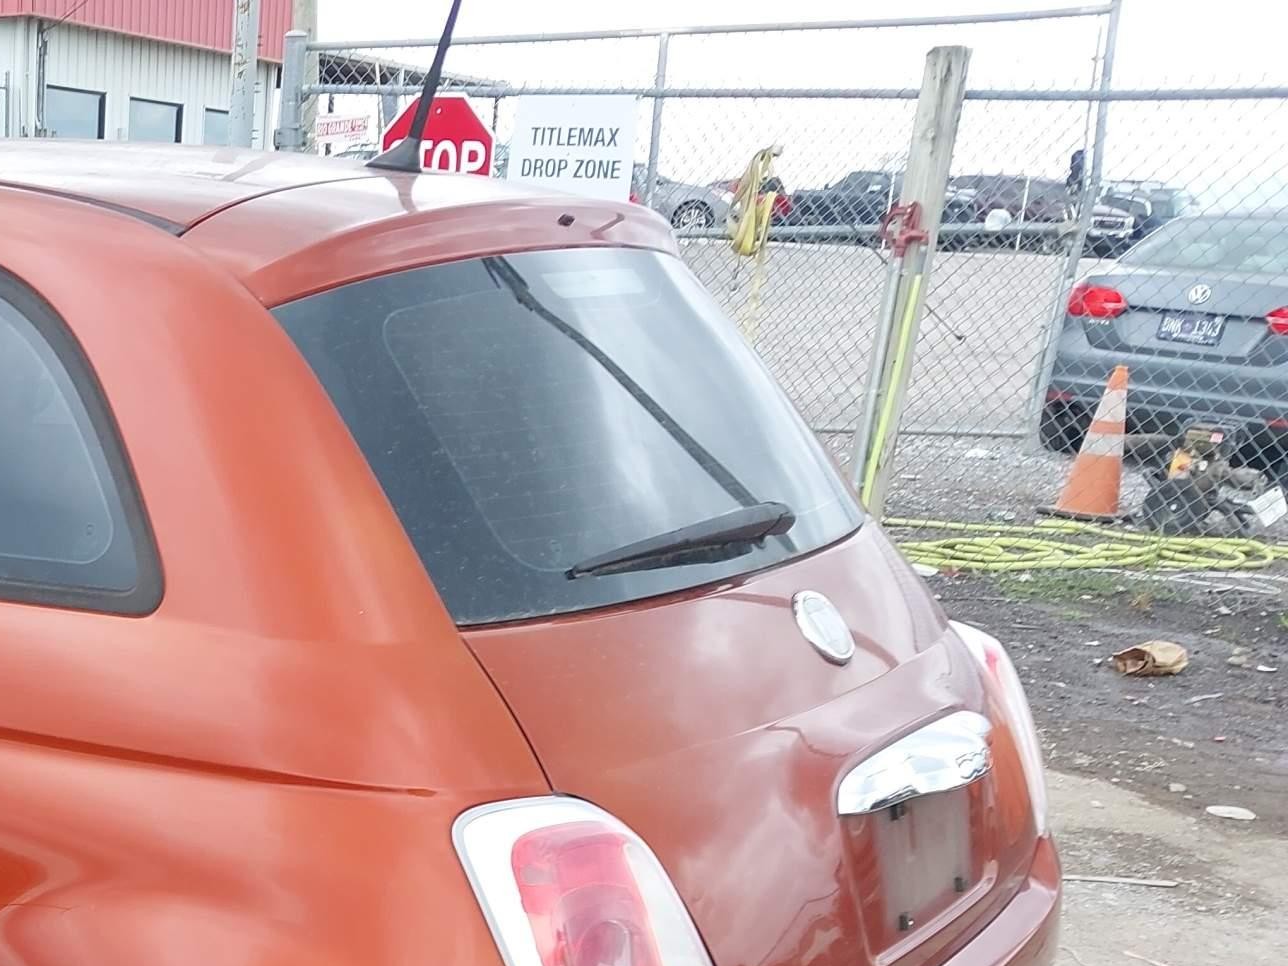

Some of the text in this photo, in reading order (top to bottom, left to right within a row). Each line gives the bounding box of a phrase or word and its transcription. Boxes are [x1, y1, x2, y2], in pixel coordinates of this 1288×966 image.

[531, 126, 620, 147] TITLEMAX
[390, 139, 487, 174] TOP
[521, 158, 622, 179] DROP ZONE
